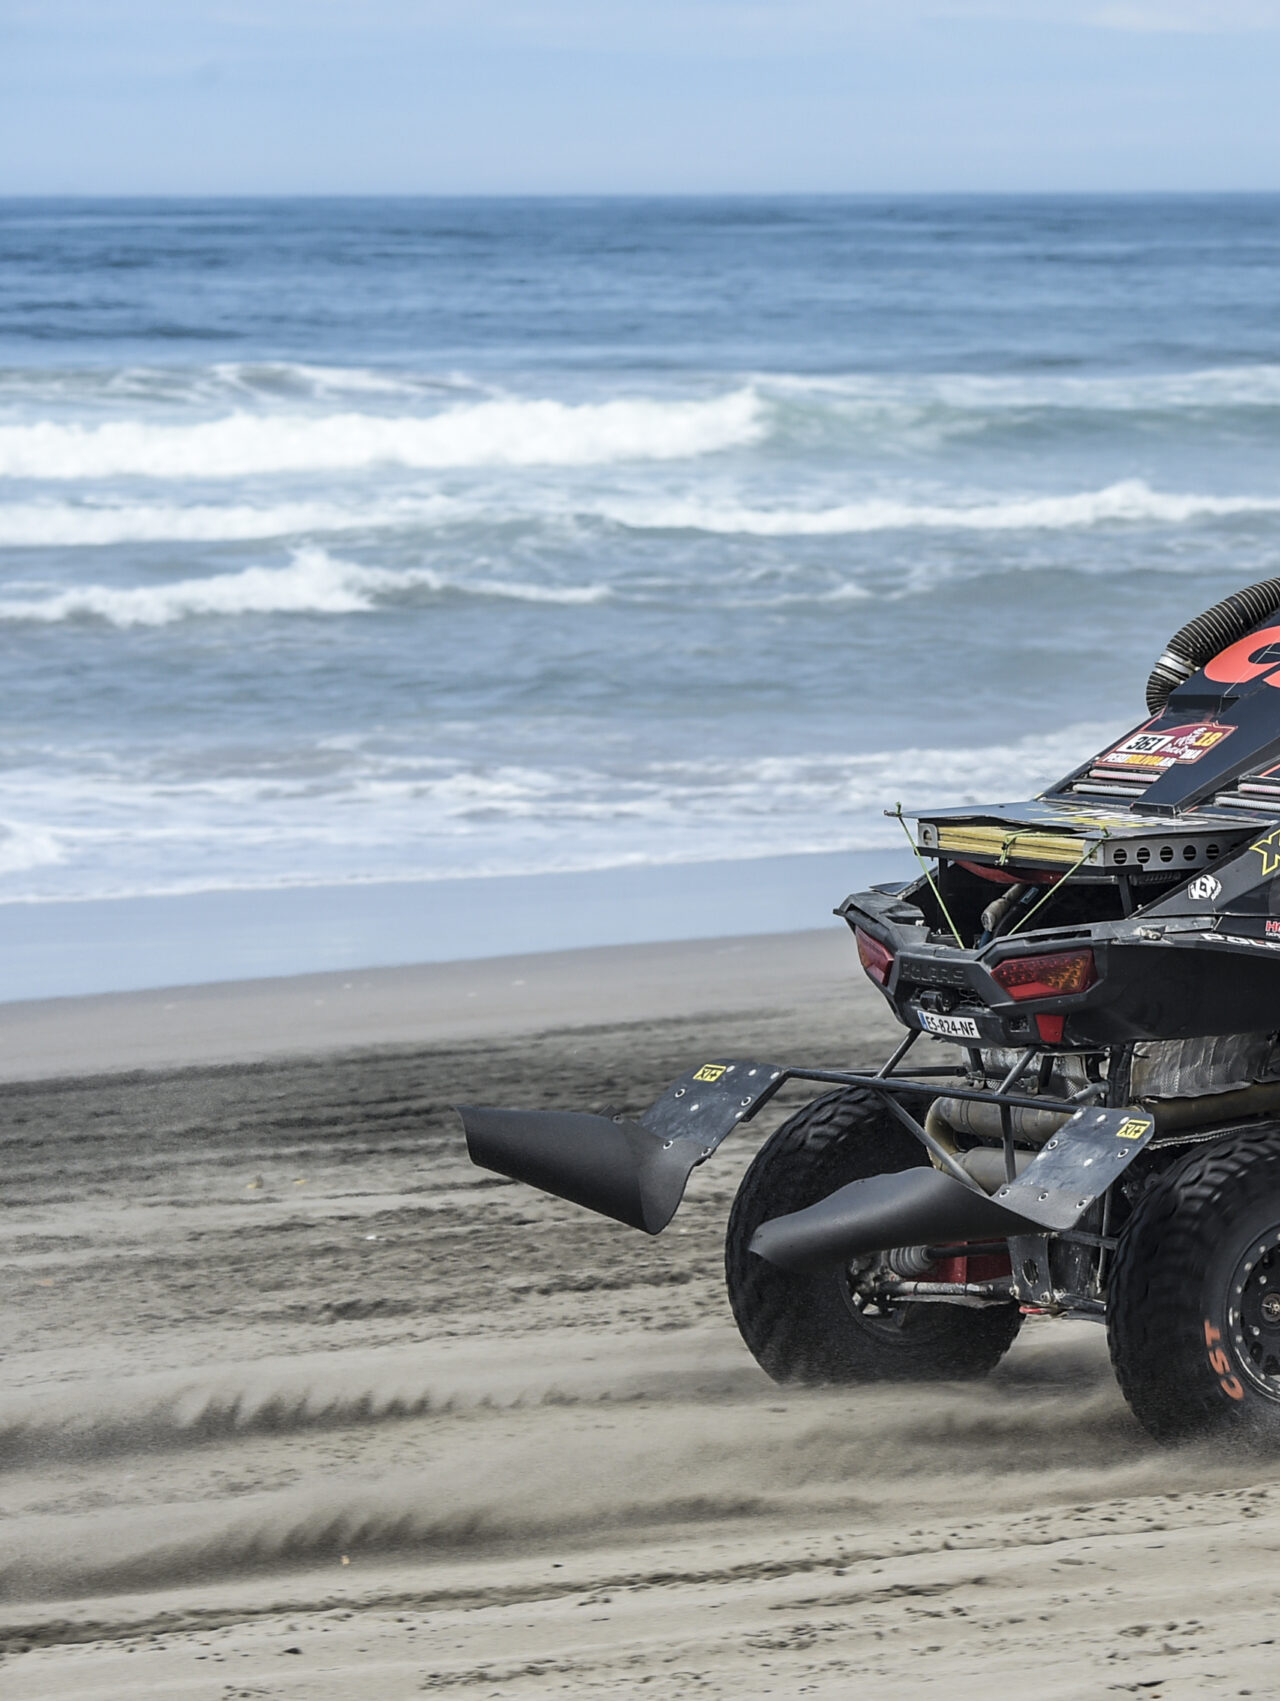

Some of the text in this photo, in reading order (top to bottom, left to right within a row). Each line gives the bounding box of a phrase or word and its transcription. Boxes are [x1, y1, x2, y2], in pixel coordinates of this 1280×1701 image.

[1126, 736, 1165, 751] 361
[925, 1015, 975, 1036] ES-824-NF
[1203, 1319, 1245, 1400] CST
